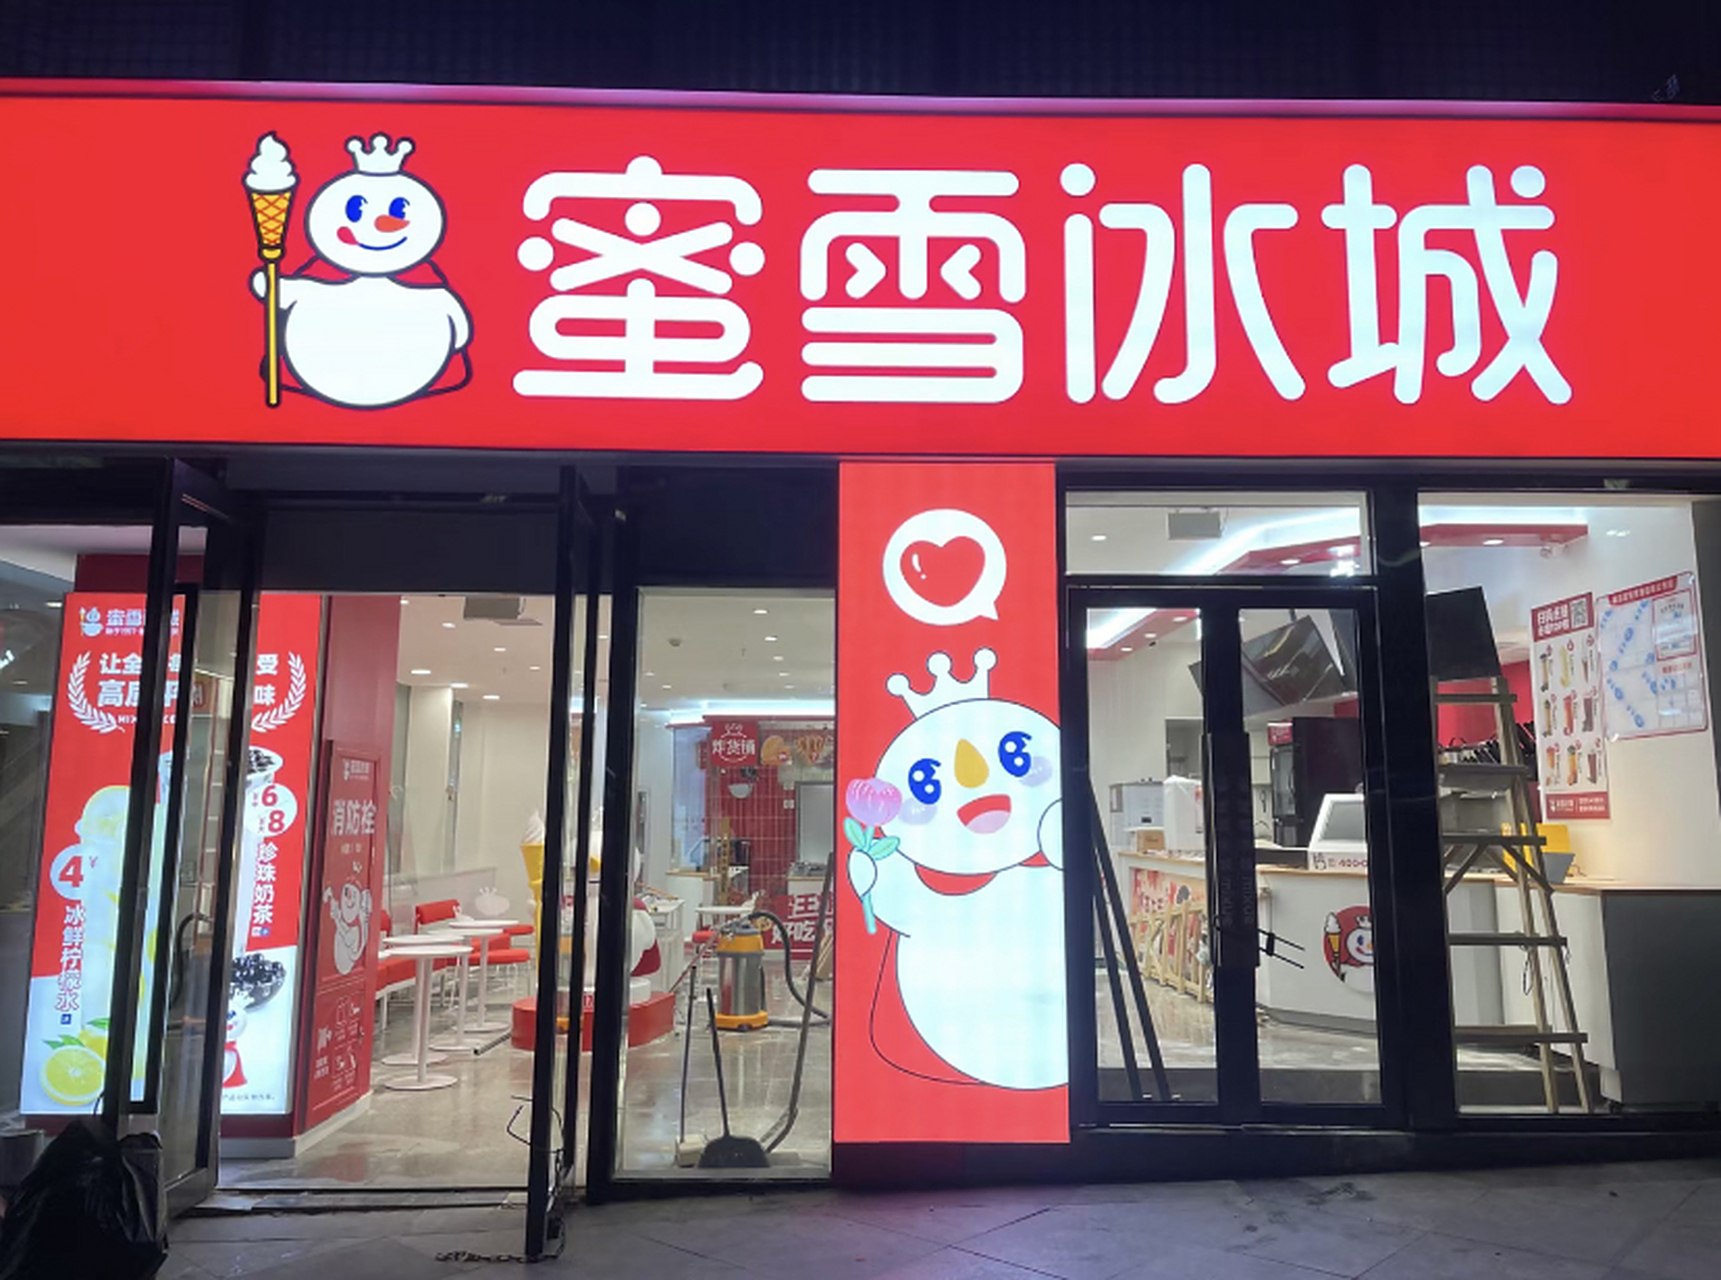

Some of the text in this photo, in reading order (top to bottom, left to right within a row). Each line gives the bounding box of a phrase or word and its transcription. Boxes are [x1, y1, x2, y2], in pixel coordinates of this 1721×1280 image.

[513, 156, 1573, 405] 蜜雪冰城
[261, 784, 278, 807] 6
[268, 809, 285, 834] 8
[332, 799, 377, 836] 消防栓
[58, 855, 84, 888] 4
[252, 842, 278, 925] 珍珠奶茶
[55, 904, 87, 1012] 冰鲜柠檬水
